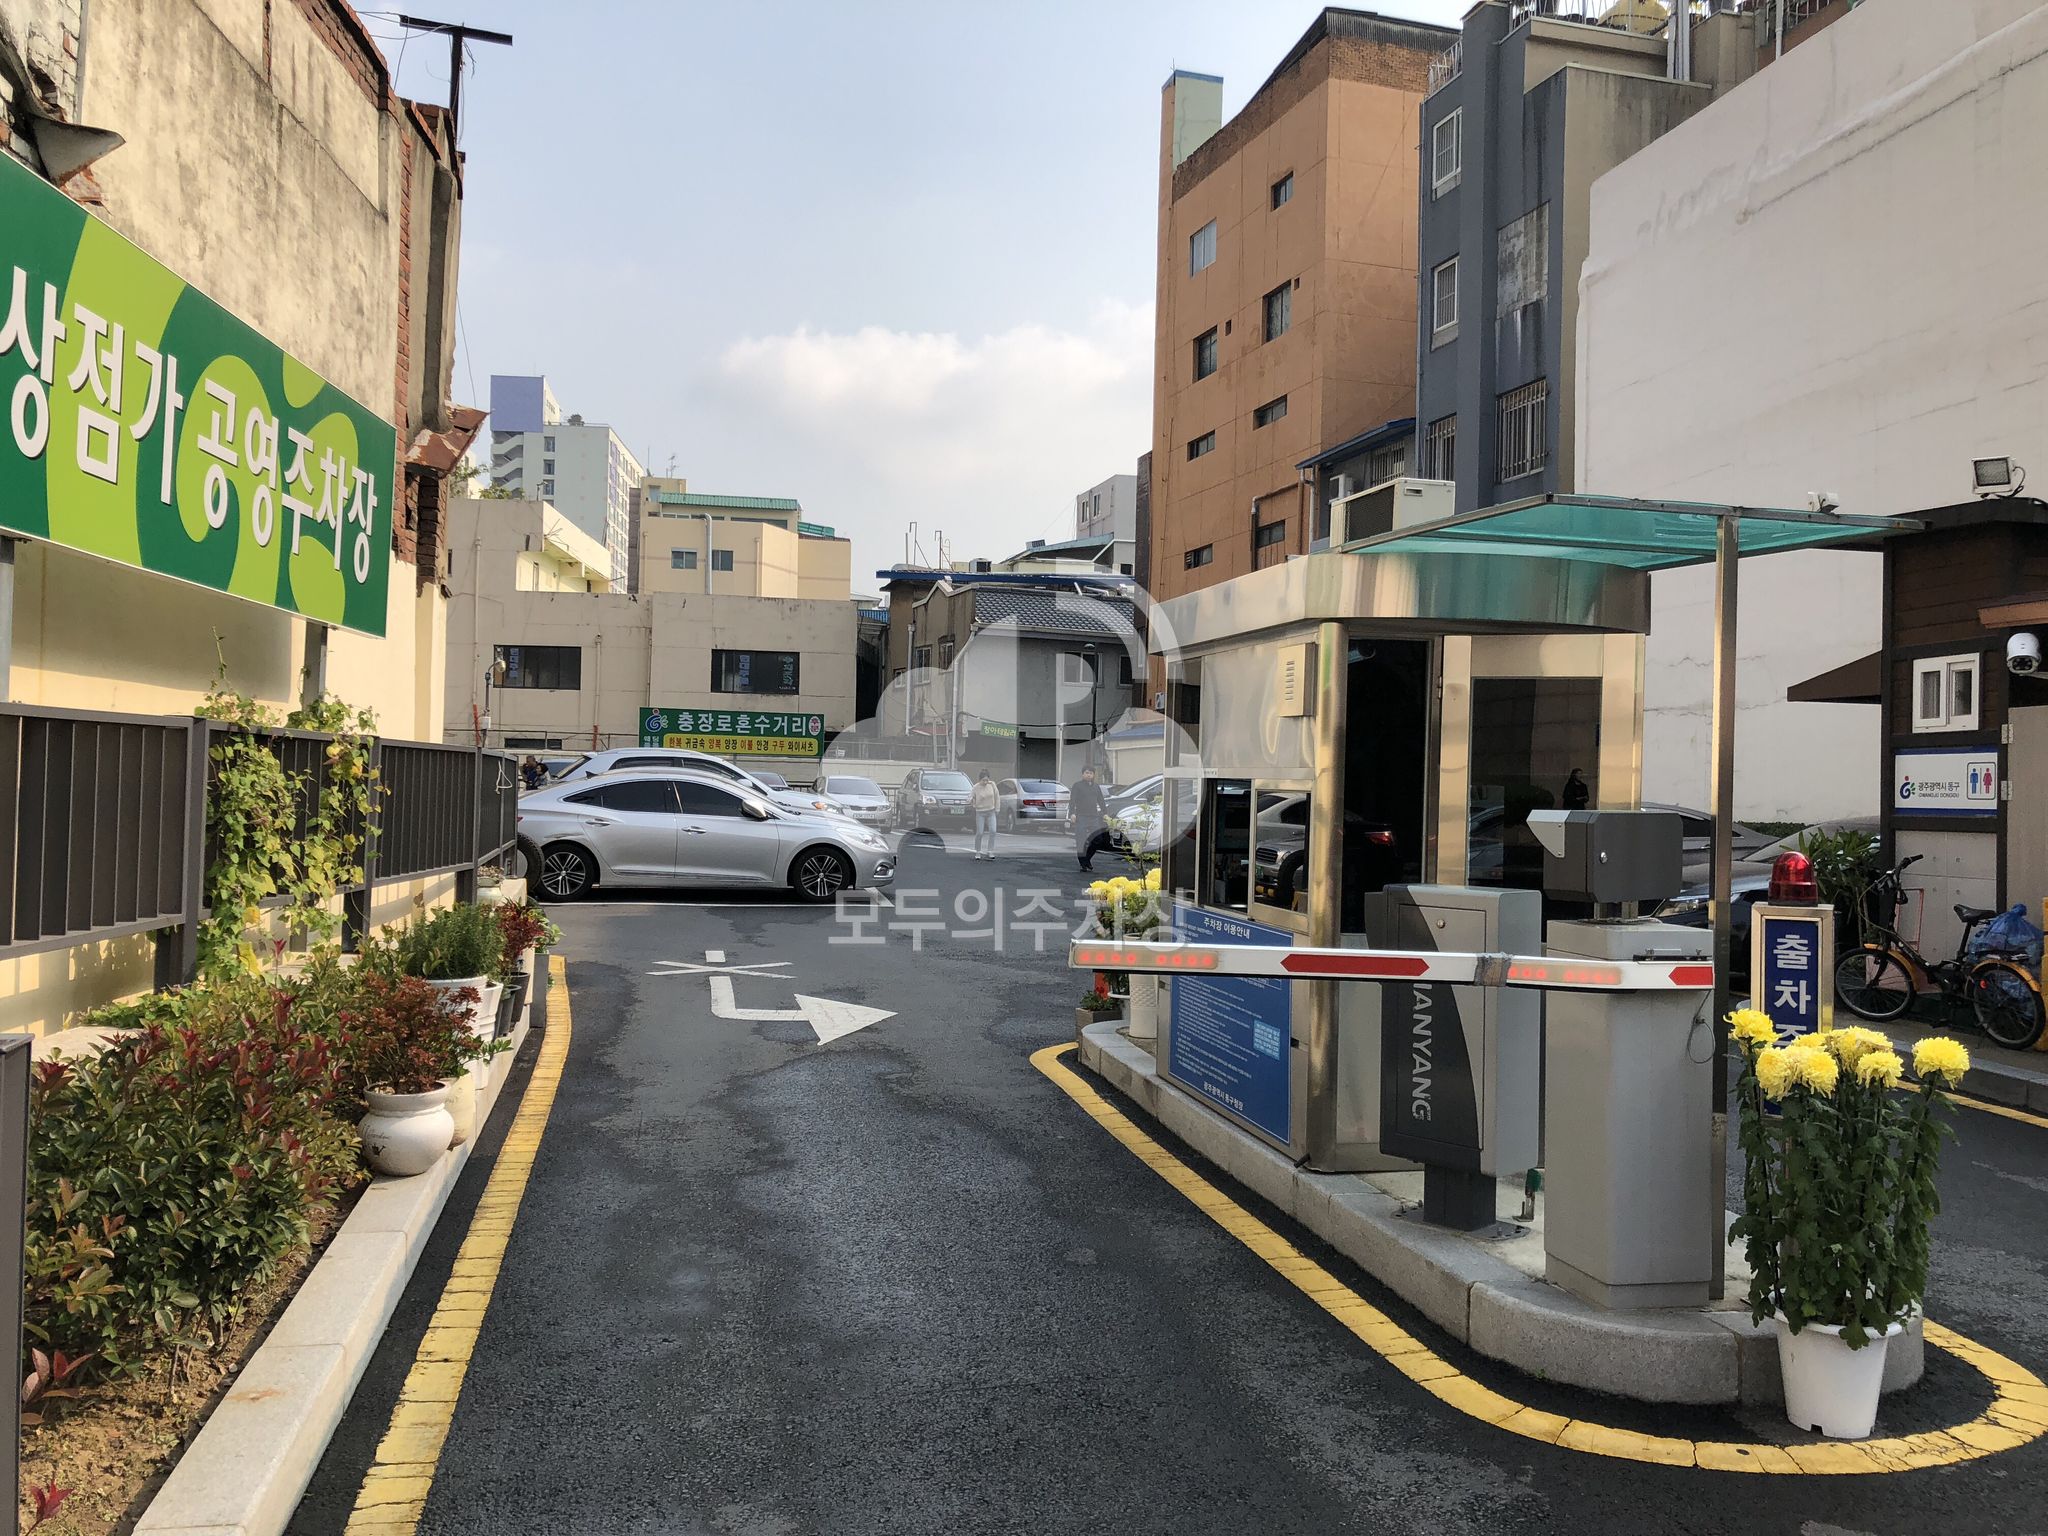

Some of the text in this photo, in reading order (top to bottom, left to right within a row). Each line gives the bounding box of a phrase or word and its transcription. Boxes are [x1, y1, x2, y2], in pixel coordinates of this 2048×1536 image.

[0, 265, 378, 584] 상점가 공영주차장
[677, 711, 807, 736] 충장로혼수거리
[669, 736, 682, 748] 한복
[685, 738, 705, 749] 귀금속
[708, 738, 721, 750] 양복
[724, 738, 737, 750] 양장
[740, 739, 753, 751] 이불
[756, 739, 769, 751] 안경
[772, 740, 785, 752] 구두
[1918, 781, 1960, 792] 광주광역시 동구
[1203, 917, 1222, 931] 주차장
[1224, 923, 1250, 939] 이용안내
[1411, 983, 1433, 1121] ANYANG
